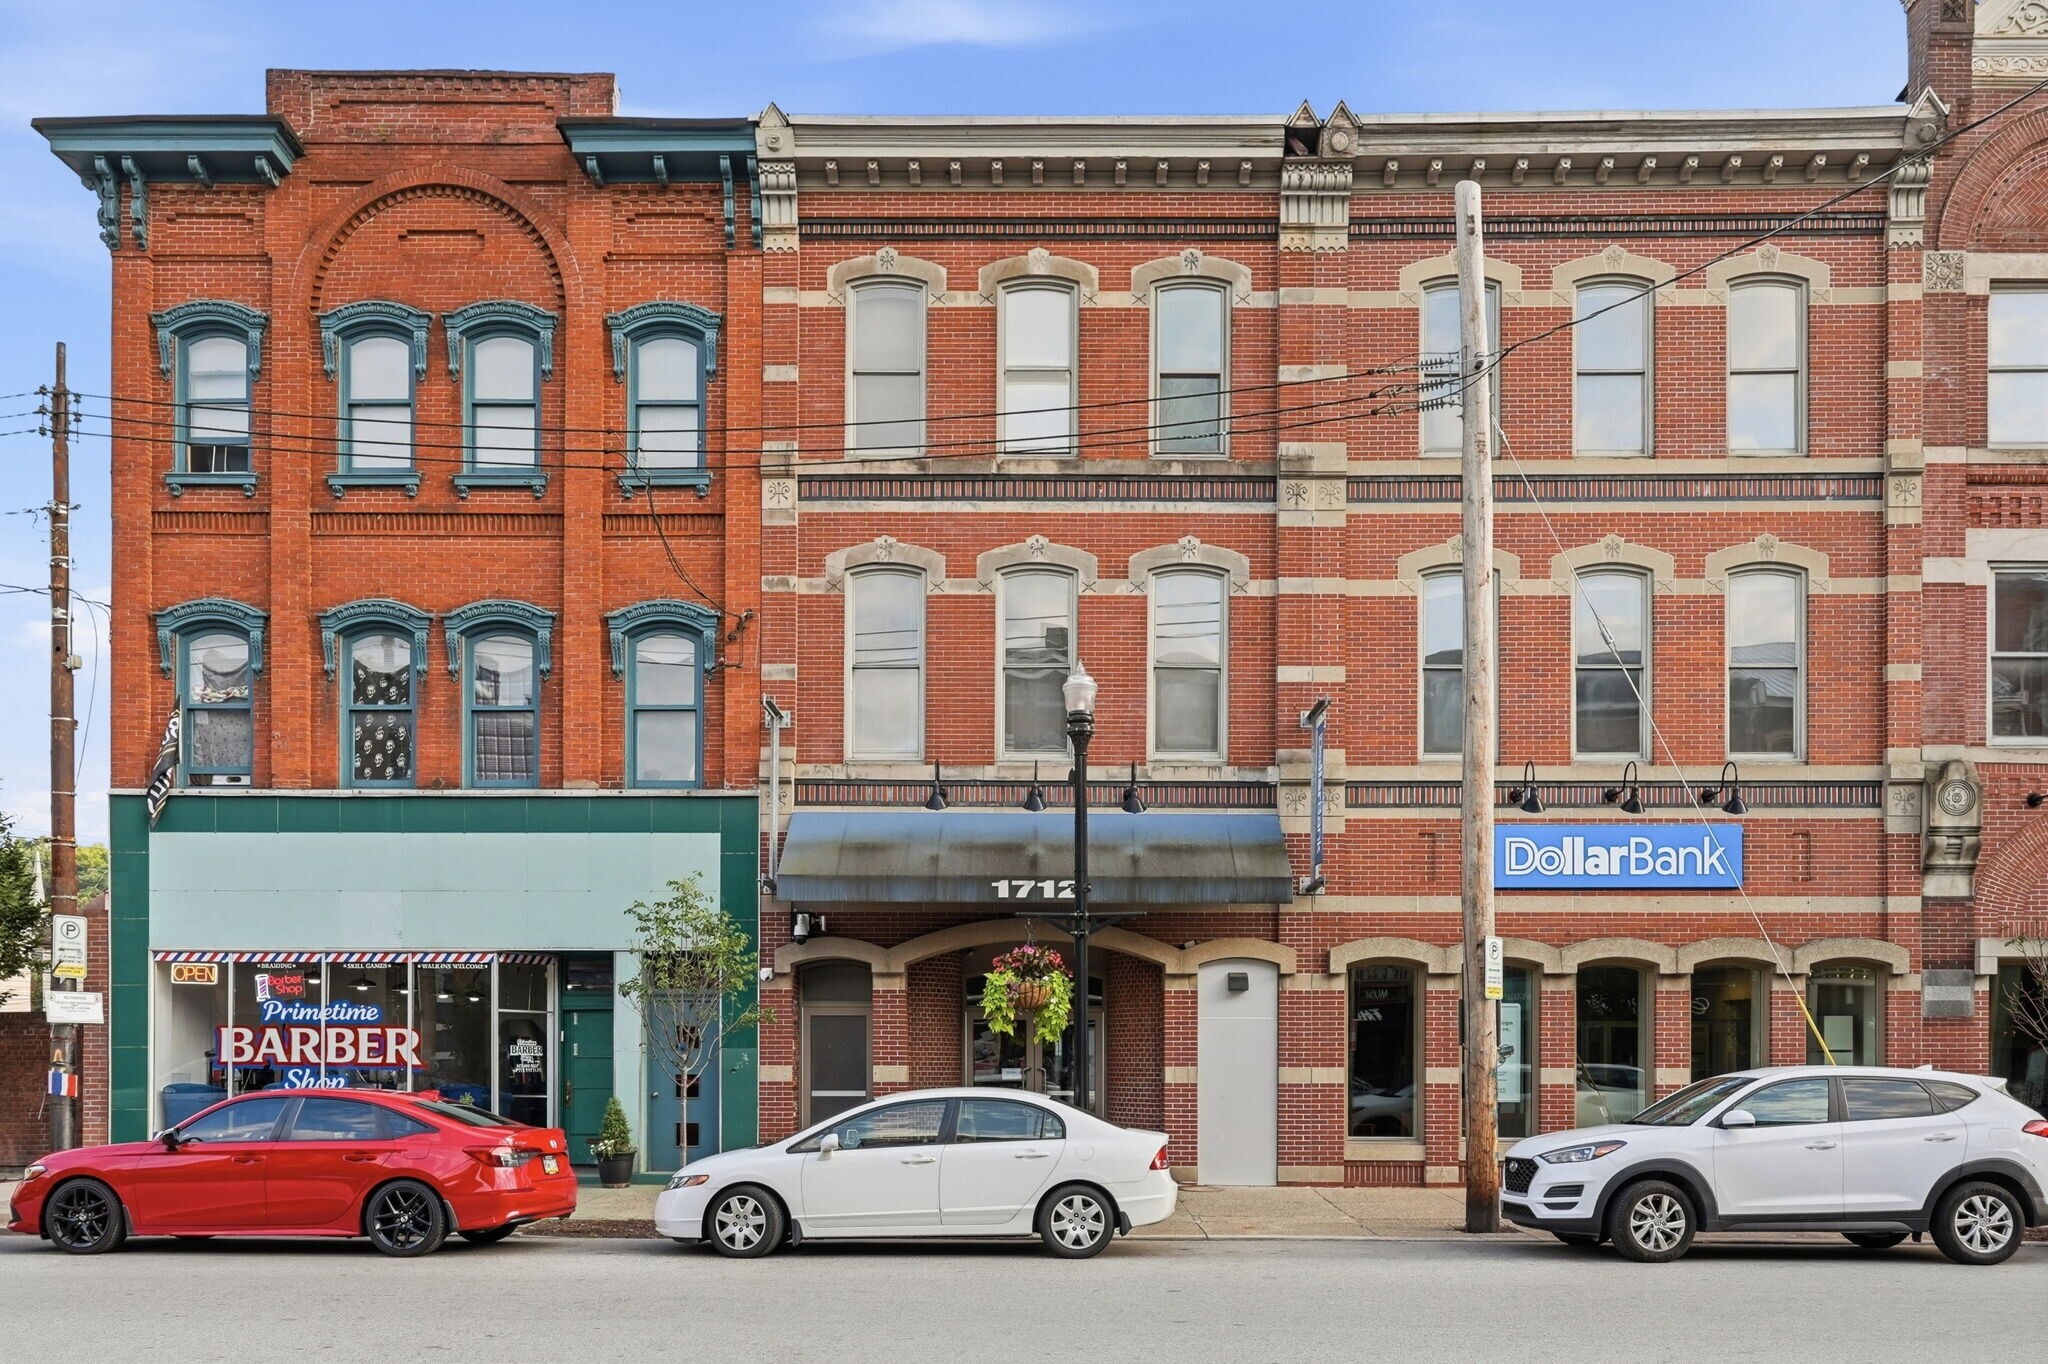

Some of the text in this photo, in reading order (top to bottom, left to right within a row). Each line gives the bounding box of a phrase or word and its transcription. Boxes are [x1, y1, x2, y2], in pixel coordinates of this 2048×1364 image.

[991, 879, 1077, 899] 1712
[66, 924, 77, 936] P
[1491, 944, 1498, 956] P
[173, 965, 215, 982] OPEN
[268, 975, 302, 986] Barber
[275, 984, 303, 996] Shop
[263, 1000, 379, 1021] Primetime
[220, 1027, 422, 1065] BARBER
[510, 1045, 543, 1055] BARBER
[284, 1068, 346, 1089] Shop
